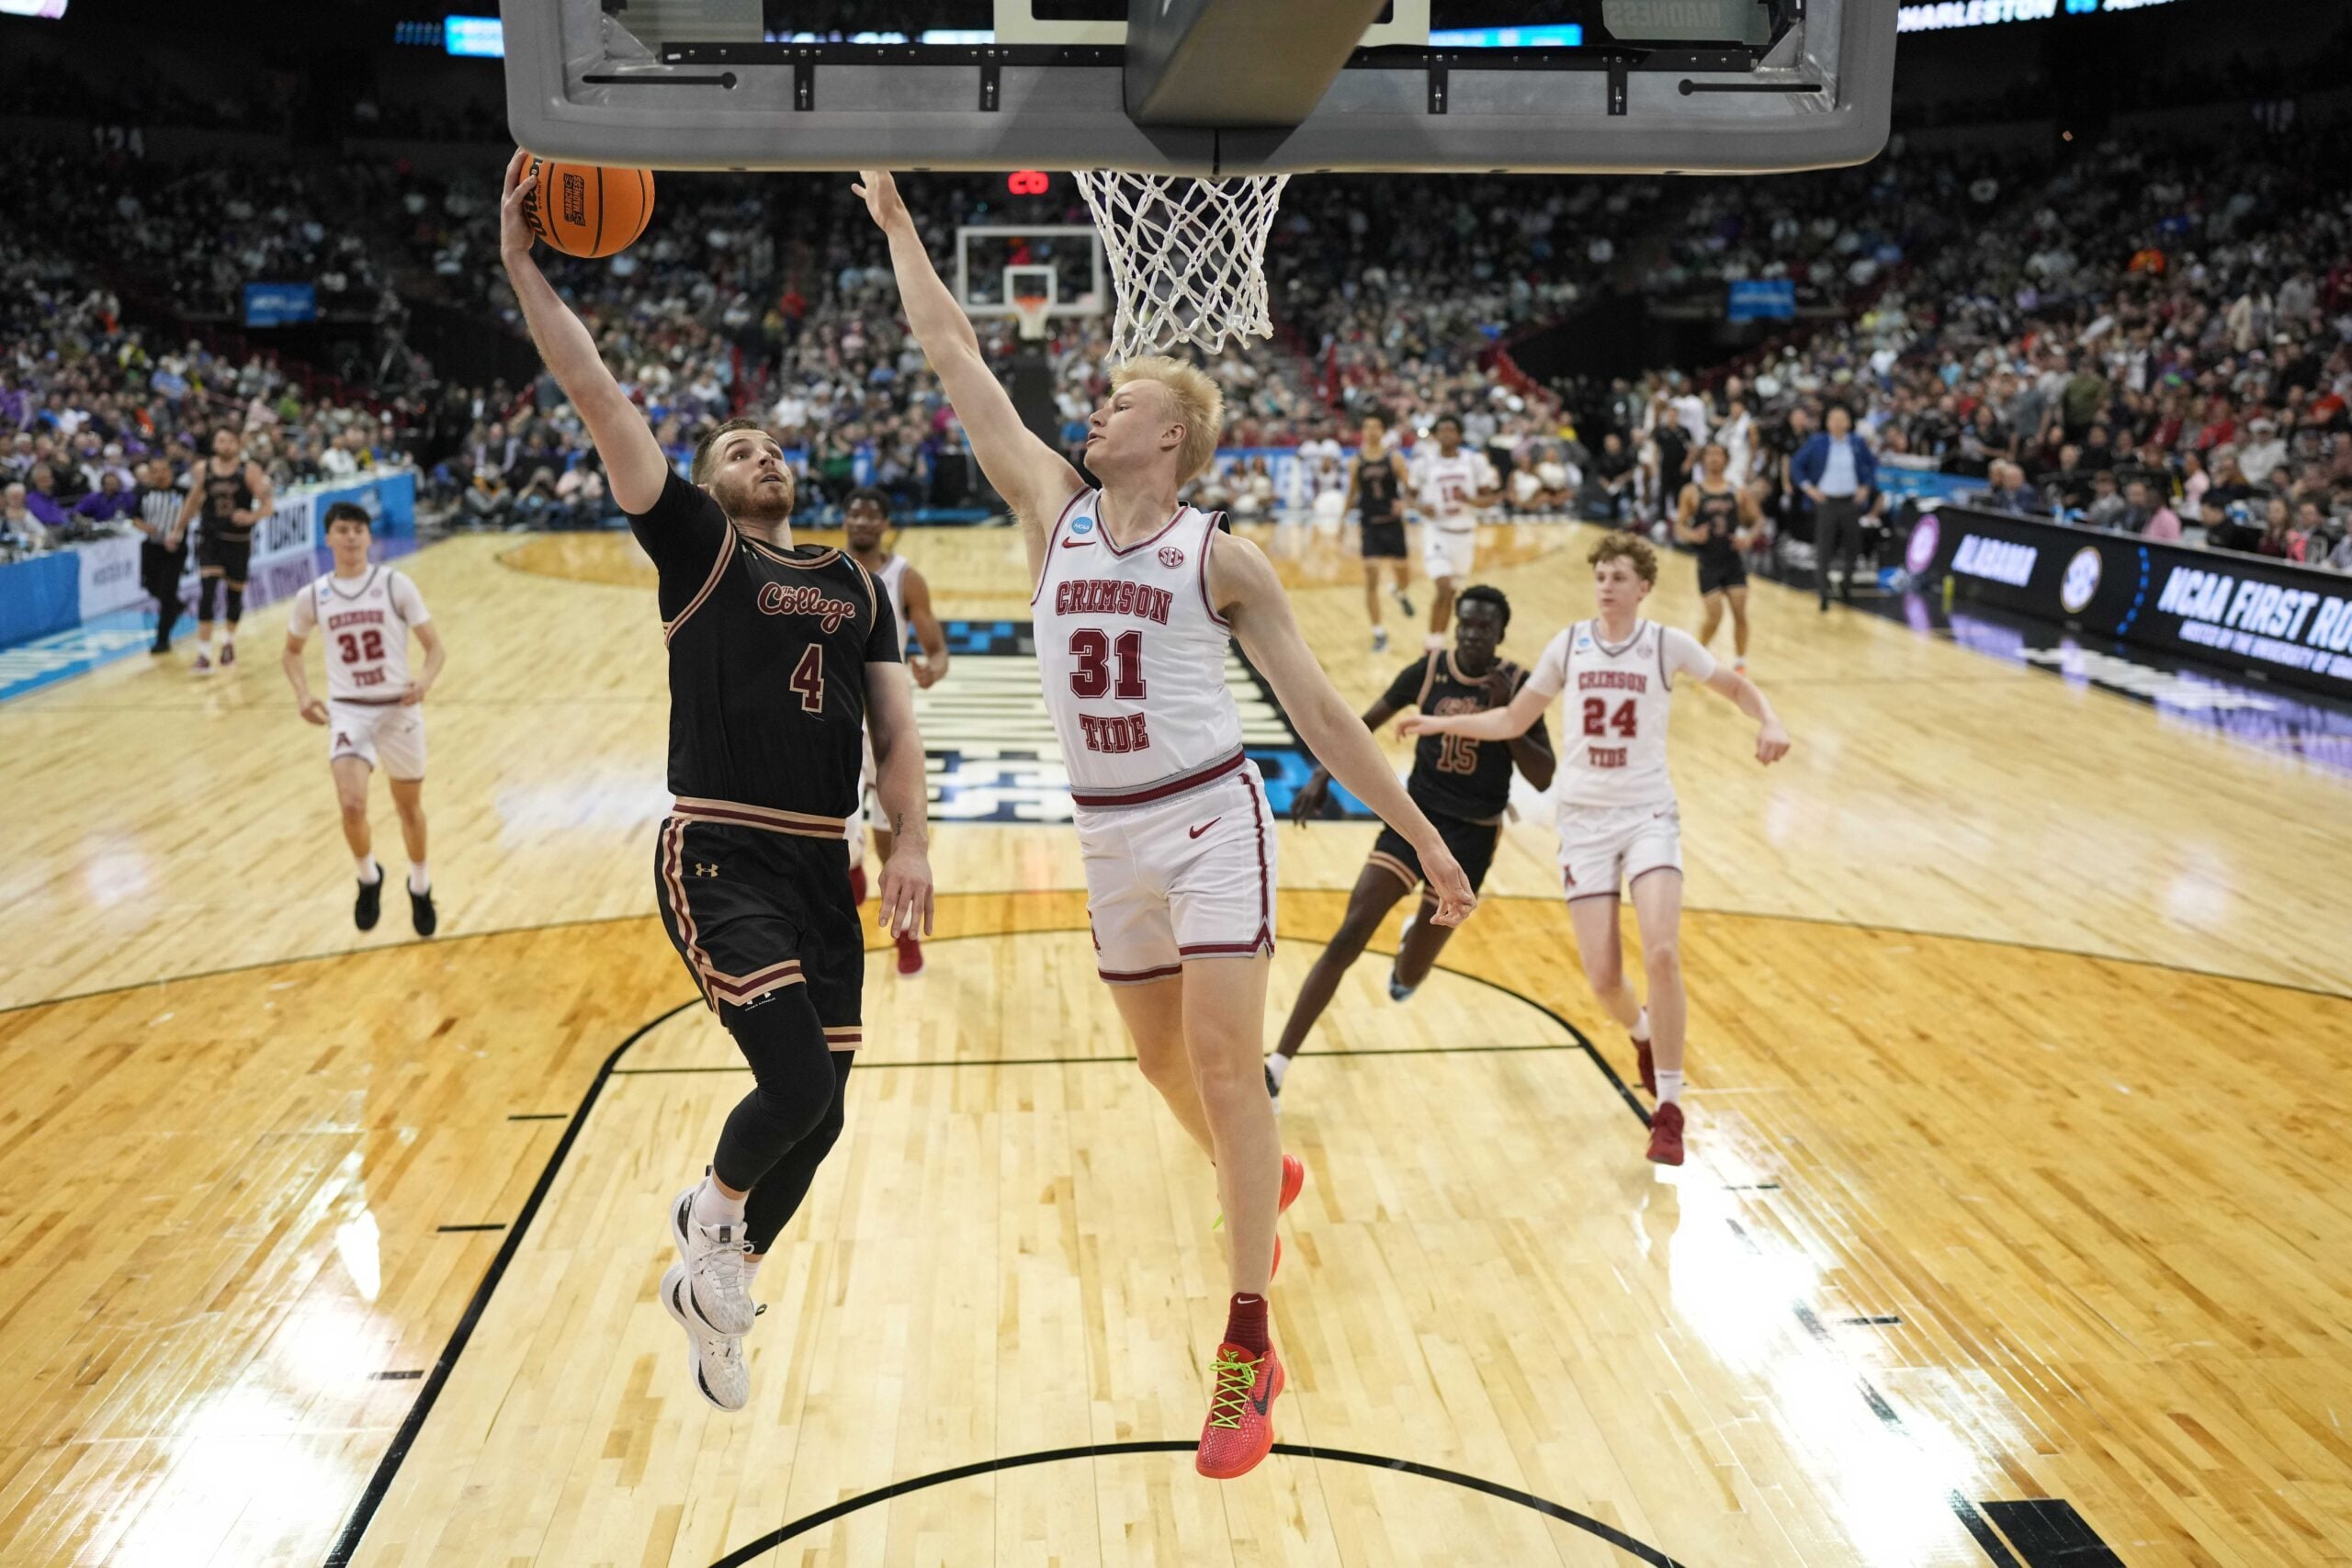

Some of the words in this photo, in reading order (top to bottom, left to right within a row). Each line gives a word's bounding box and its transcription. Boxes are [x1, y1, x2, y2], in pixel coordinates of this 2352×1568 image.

[1896, 0, 2059, 33] HARLESTON
[1159, 547, 1183, 567] SEC
[757, 581, 856, 634] College
[1056, 580, 1173, 625] CRIMSON
[2157, 566, 2234, 623] NCAA
[2224, 580, 2321, 642] FIRST
[2306, 596, 2352, 656] RO
[337, 629, 386, 664] 32
[1069, 627, 1147, 699] 31
[789, 642, 824, 714] 4
[1578, 671, 1647, 694] CRIMSON
[1079, 712, 1149, 753] TIDE
[1583, 696, 1637, 739] 24
[1436, 734, 1479, 774] 15
[1588, 745, 1628, 768] TIDE
